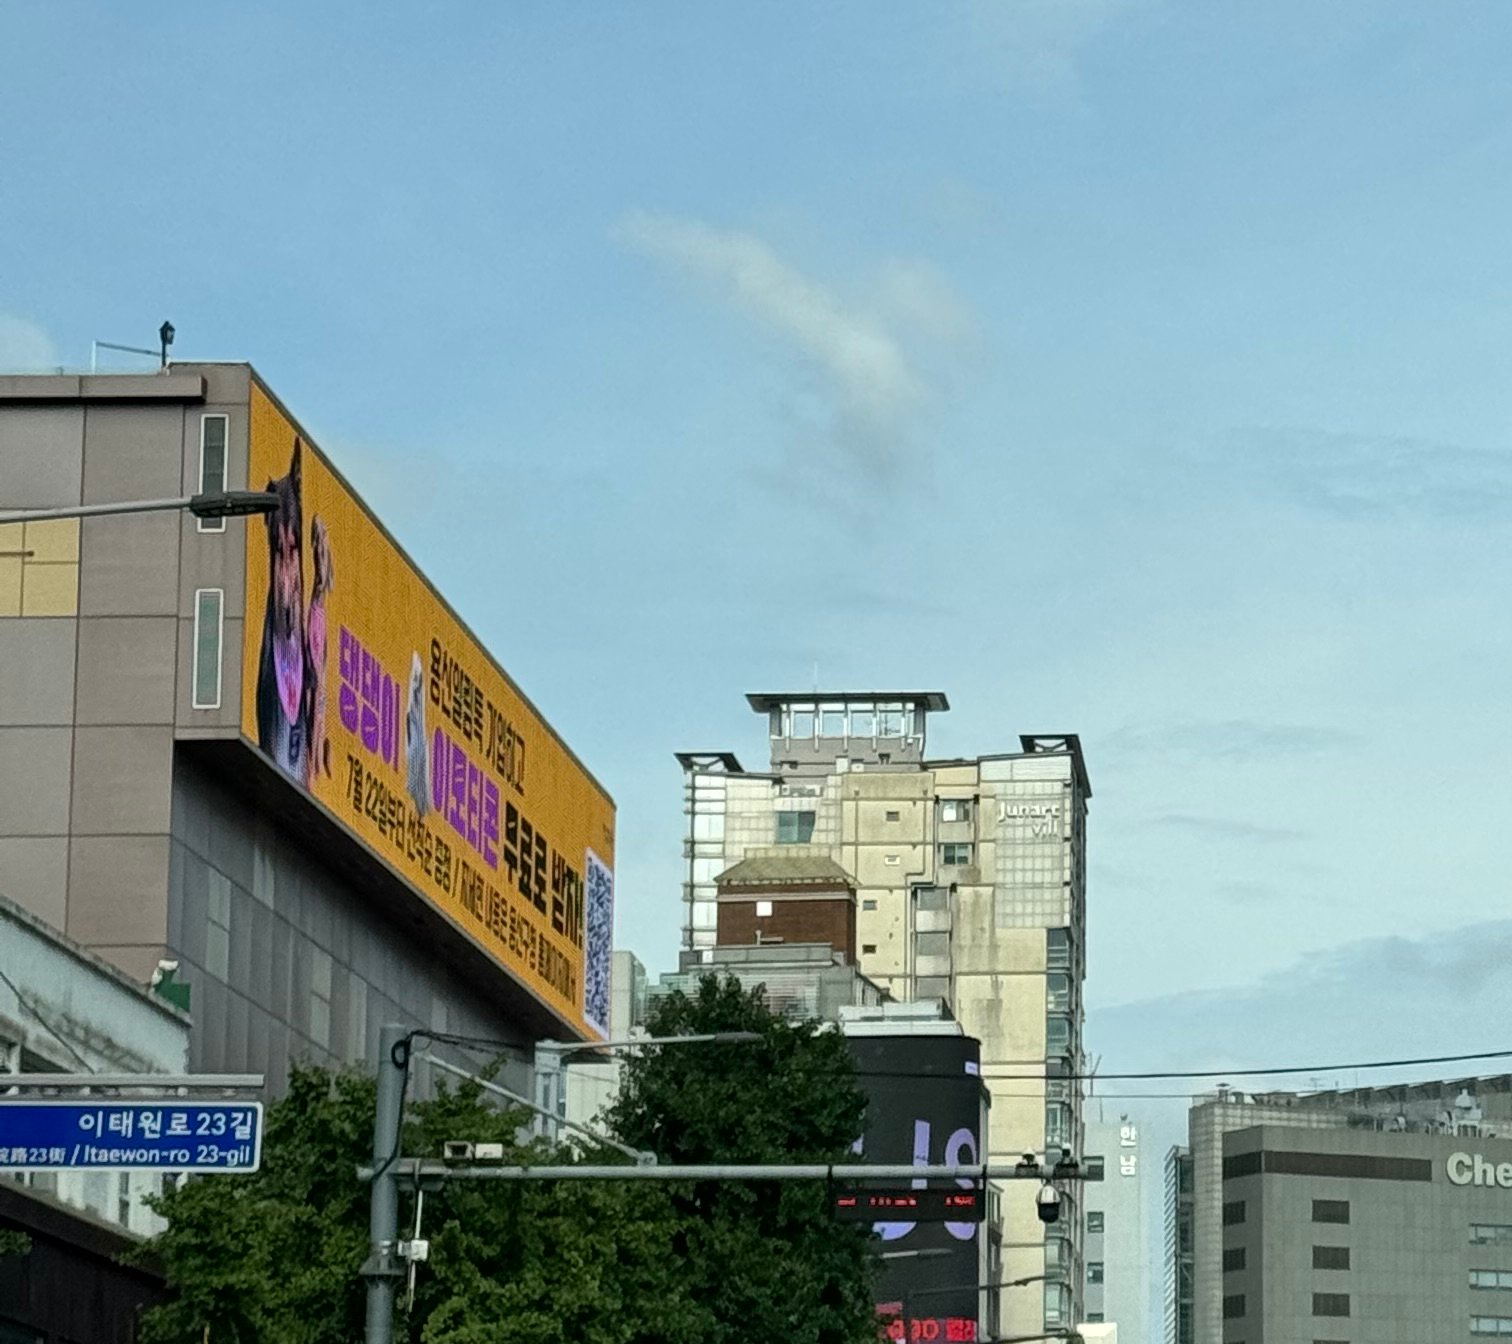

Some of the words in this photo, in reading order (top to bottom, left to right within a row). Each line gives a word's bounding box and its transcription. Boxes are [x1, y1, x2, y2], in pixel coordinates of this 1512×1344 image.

[339, 623, 400, 774] 댕댕이
[432, 726, 499, 872] 이모티콘
[504, 800, 548, 917] 무료로
[84, 1144, 190, 1164] Itaewon-ro
[196, 1145, 250, 1167] 23-gil
